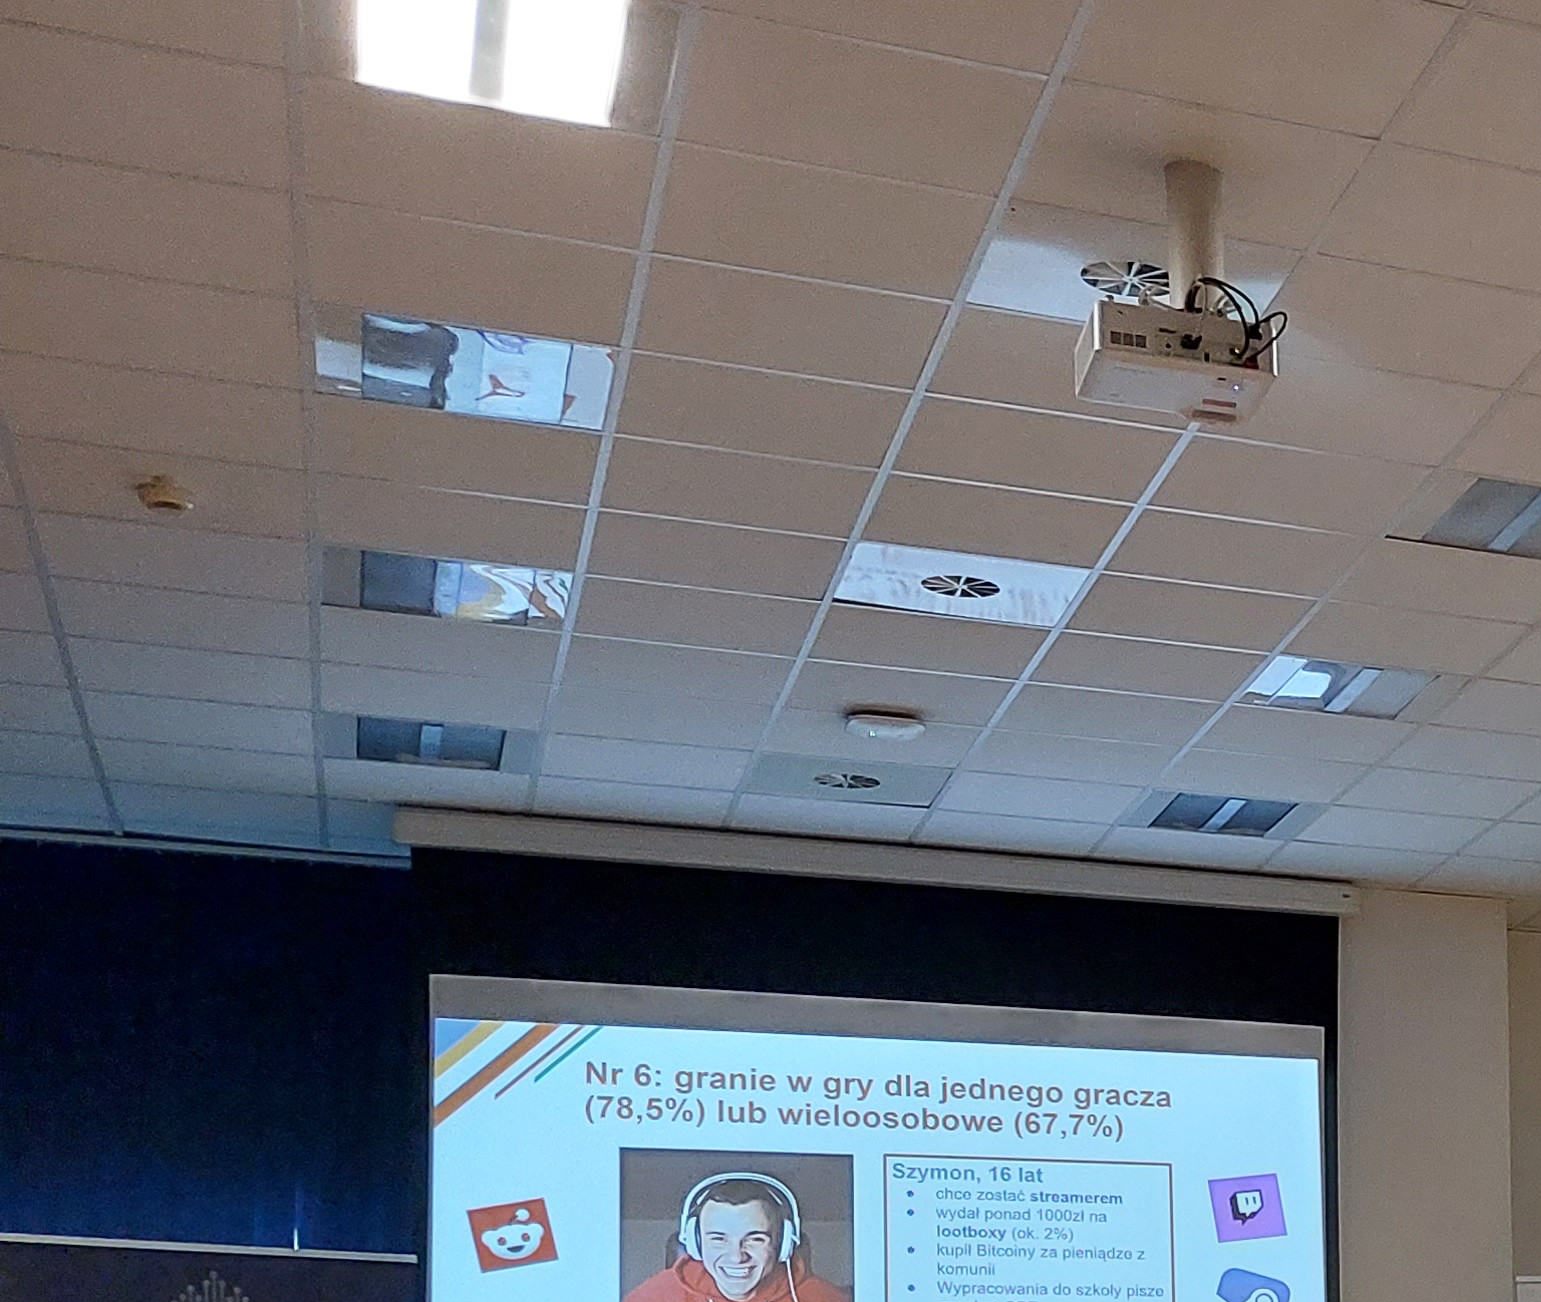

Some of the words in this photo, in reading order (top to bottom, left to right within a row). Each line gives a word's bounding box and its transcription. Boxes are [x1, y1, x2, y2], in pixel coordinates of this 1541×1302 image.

[586, 1061, 623, 1085] Nr
[634, 1064, 662, 1088] 6:
[675, 1067, 777, 1094] granie
[786, 1073, 812, 1093] w
[823, 1074, 874, 1102] gry
[885, 1073, 930, 1098] dla
[939, 1077, 1063, 1108] jednego
[1073, 1085, 1172, 1110] gracza
[585, 1096, 706, 1126] (78,5%)
[717, 1099, 767, 1124] lub
[777, 1102, 1004, 1134] wieloosobowe
[1014, 1111, 1123, 1142] (67,7%)
[892, 1163, 981, 1184] Szymon,
[989, 1167, 1011, 1183] 16
[1019, 1168, 1043, 1183] lat
[936, 1187, 971, 1200] chce
[977, 1190, 1025, 1202] zostać
[1030, 1191, 1123, 1205] streamerem
[936, 1207, 980, 1220] wydał
[984, 1210, 1030, 1222] ponad
[1089, 1212, 1107, 1223] na
[937, 1225, 1006, 1241] lootboxy
[1011, 1227, 1039, 1242] (ok.
[1044, 1227, 1074, 1243] 2%)
[937, 1244, 972, 1259] kupił
[977, 1244, 1035, 1260] Bitcoiny
[1040, 1248, 1058, 1258] za
[1063, 1247, 1133, 1262] pieniądze
[1137, 1250, 1146, 1260] z
[937, 1263, 995, 1275] komunii
[937, 1281, 1048, 1295] Wypracowania
[1053, 1282, 1071, 1295] do
[1076, 1284, 1121, 1298] szkoły
[1127, 1285, 1164, 1299] pisze
